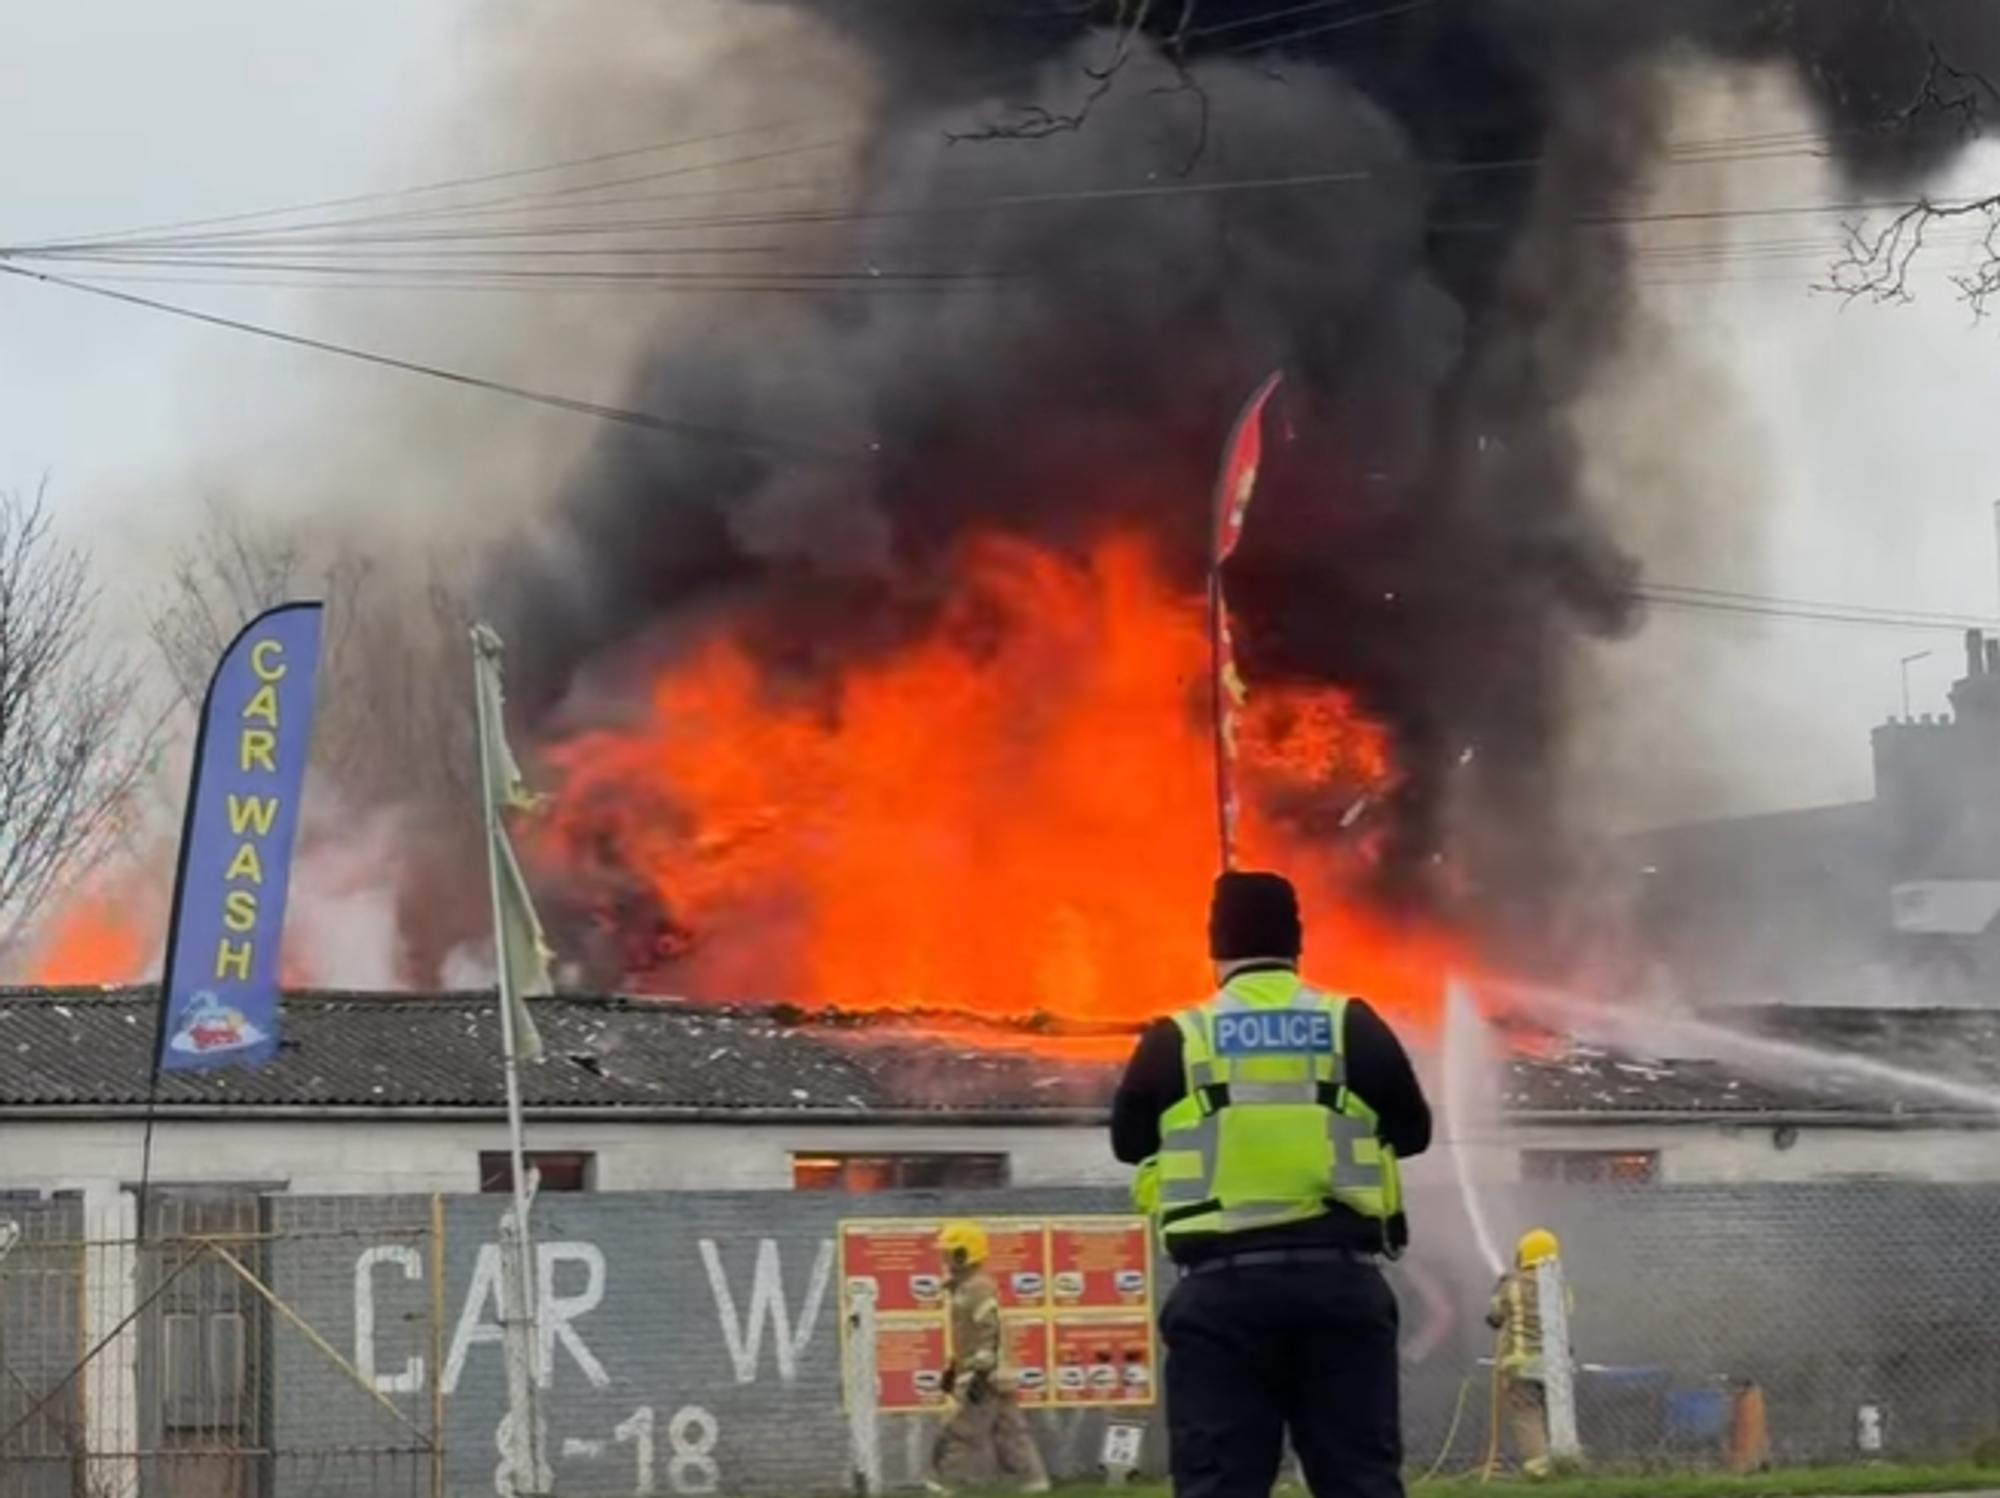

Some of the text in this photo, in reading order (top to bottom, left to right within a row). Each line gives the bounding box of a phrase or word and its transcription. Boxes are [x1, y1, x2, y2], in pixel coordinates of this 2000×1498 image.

[215, 639, 287, 981] CAR WASH
[1217, 1014, 1330, 1048] POLICE
[354, 1240, 612, 1394] CAR
